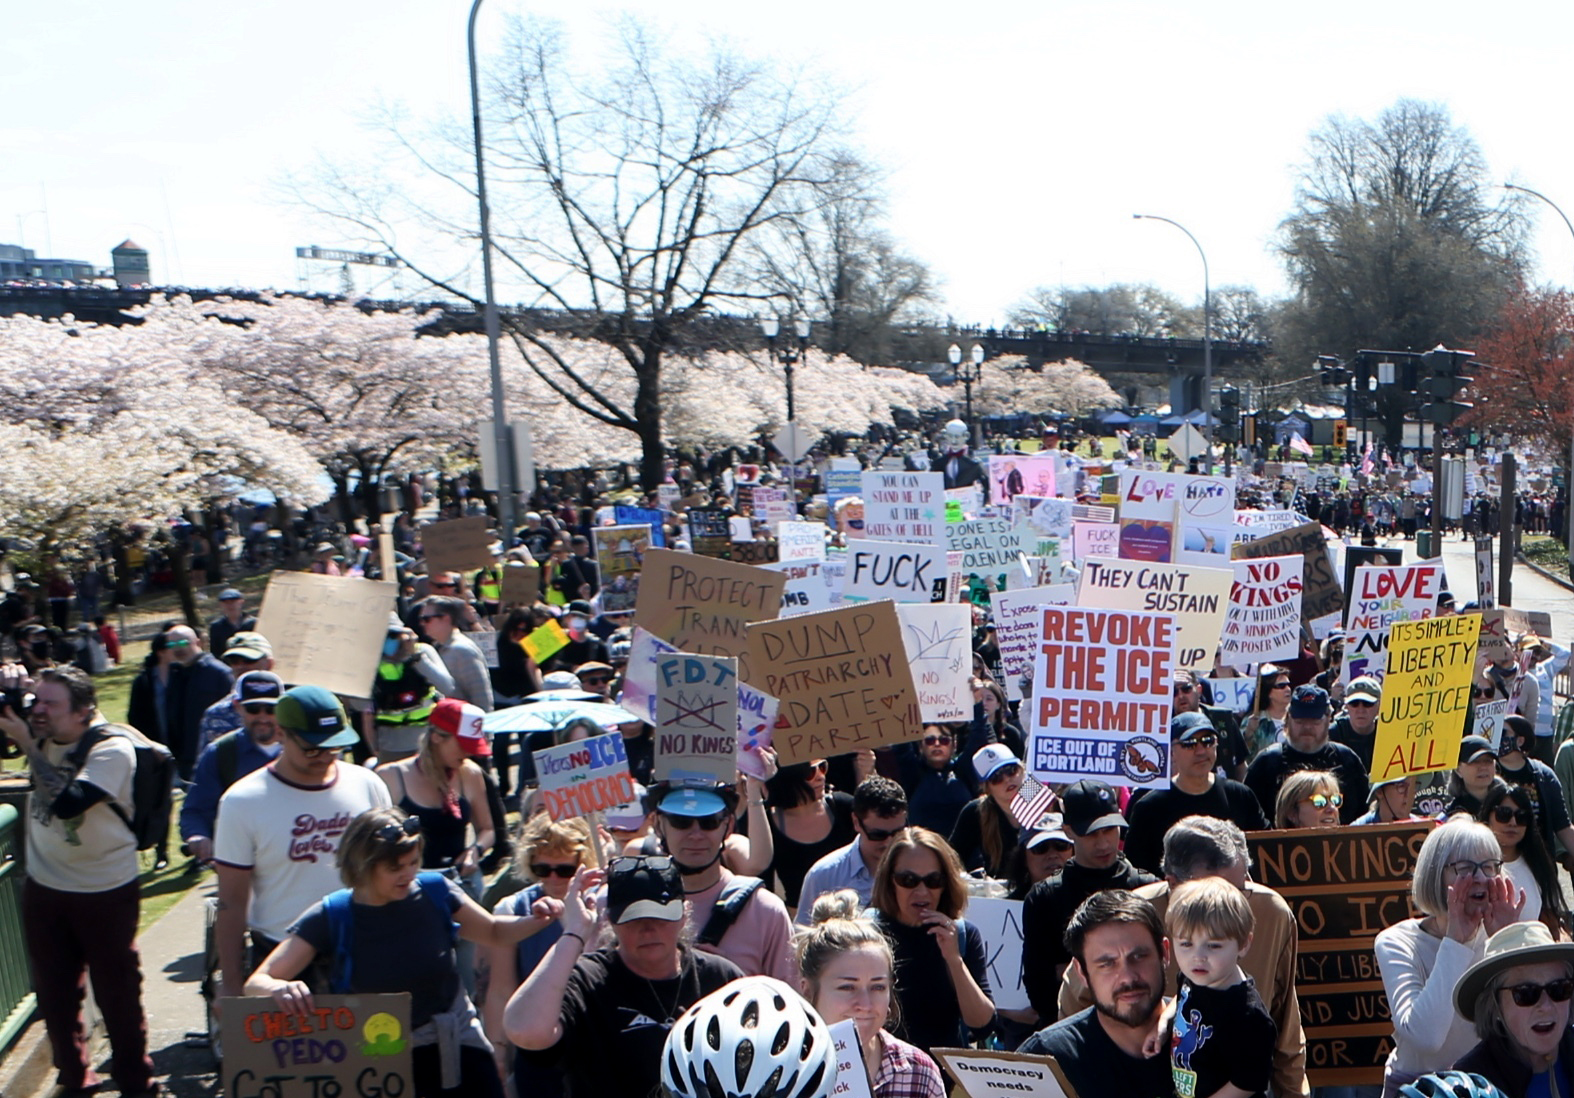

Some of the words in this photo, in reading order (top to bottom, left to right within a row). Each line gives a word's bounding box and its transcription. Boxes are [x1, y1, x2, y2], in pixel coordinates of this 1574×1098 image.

[1127, 475, 1175, 503] LOVE
[958, 523, 984, 536] ONE
[1000, 535, 1020, 547] ON
[1088, 530, 1117, 541] FUCK
[1090, 544, 1111, 554] ICE
[853, 552, 931, 592] FUCK
[1087, 563, 1133, 588] THEY
[1137, 568, 1189, 593] CAN'T
[1246, 562, 1280, 583] NO
[1362, 567, 1435, 599] LOVE
[668, 565, 773, 611] PROTECT
[1229, 575, 1303, 607] KINGS
[1144, 593, 1219, 613] SUSTAIN
[1229, 607, 1249, 622] OUT
[1358, 599, 1404, 615] YOUR
[1042, 609, 1172, 648] REVOKE
[1351, 608, 1432, 631] NEIGHBOR
[1416, 617, 1474, 640] SIMPLE:
[762, 614, 875, 662] DUMP
[1241, 639, 1273, 653] POSER
[1180, 649, 1206, 667] UP
[1386, 640, 1477, 675] LIBERTY
[661, 659, 736, 690] F.D.T.
[766, 653, 892, 695] PATRIARCHY
[922, 671, 939, 685] NO
[1042, 645, 1106, 692] THE
[1115, 649, 1170, 696] ICE
[1411, 671, 1445, 690] AND
[919, 686, 956, 705] KINGS!
[1381, 686, 1470, 724] JUSTICE
[790, 688, 875, 728] DATE
[1039, 696, 1169, 735] PERMIT!
[1406, 721, 1434, 740] FOR
[569, 750, 591, 768] NO
[584, 733, 627, 769] ICE
[660, 734, 685, 755] NO
[692, 734, 735, 754] KINGS
[1037, 738, 1062, 755] ICE
[1067, 739, 1097, 756] OUT
[1100, 742, 1117, 758] OF
[1036, 755, 1117, 773] PORTLAND
[1383, 739, 1446, 779] ALL
[291, 812, 351, 838] Dadd
[1257, 843, 1312, 885] NO
[272, 1038, 348, 1069] PEDO
[1306, 1040, 1353, 1065] OR
[956, 1061, 1044, 1080] Democracy
[1175, 1072, 1193, 1084] LEFT
[987, 1079, 1034, 1092] needs
